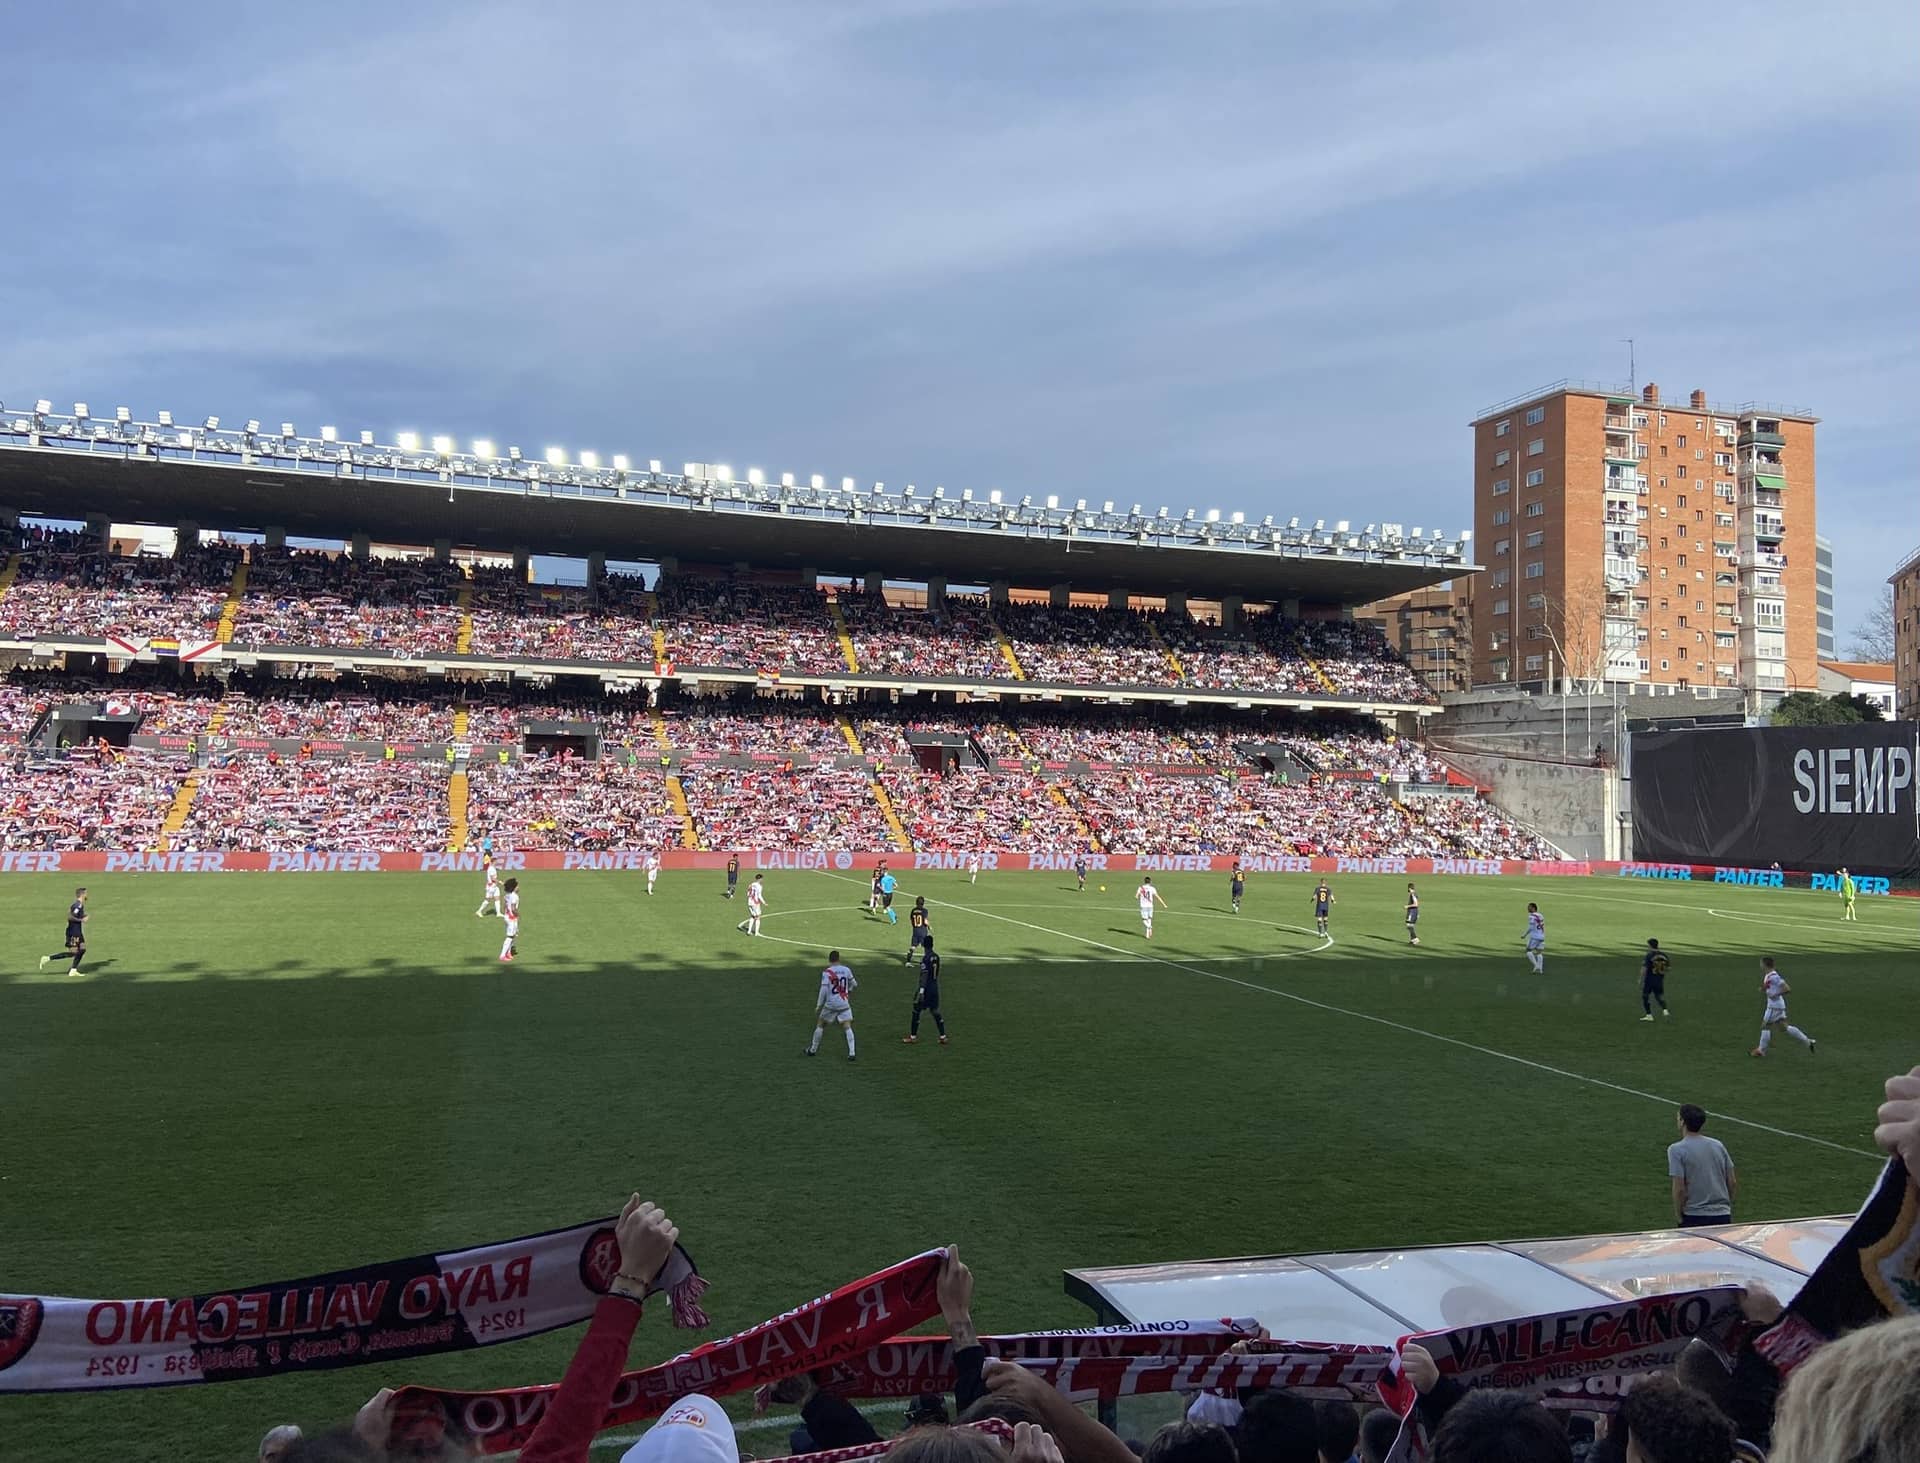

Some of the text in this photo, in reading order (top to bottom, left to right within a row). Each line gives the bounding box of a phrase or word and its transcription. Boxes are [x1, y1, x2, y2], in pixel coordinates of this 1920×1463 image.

[1793, 746, 1920, 814] SIEMP
[106, 851, 225, 872] PANTER
[269, 851, 381, 872] PANTER
[756, 851, 829, 870] LALIGA
[1136, 854, 1212, 871] PANTER
[1239, 856, 1312, 872] PANTER
[1337, 857, 1407, 874] PANTER
[1432, 859, 1502, 875] PANTER
[1619, 862, 1692, 881] PANTER
[1714, 866, 1784, 888] PANTER
[1319, 891, 1327, 903] 8
[1445, 1295, 1711, 1373] VALLECANO
